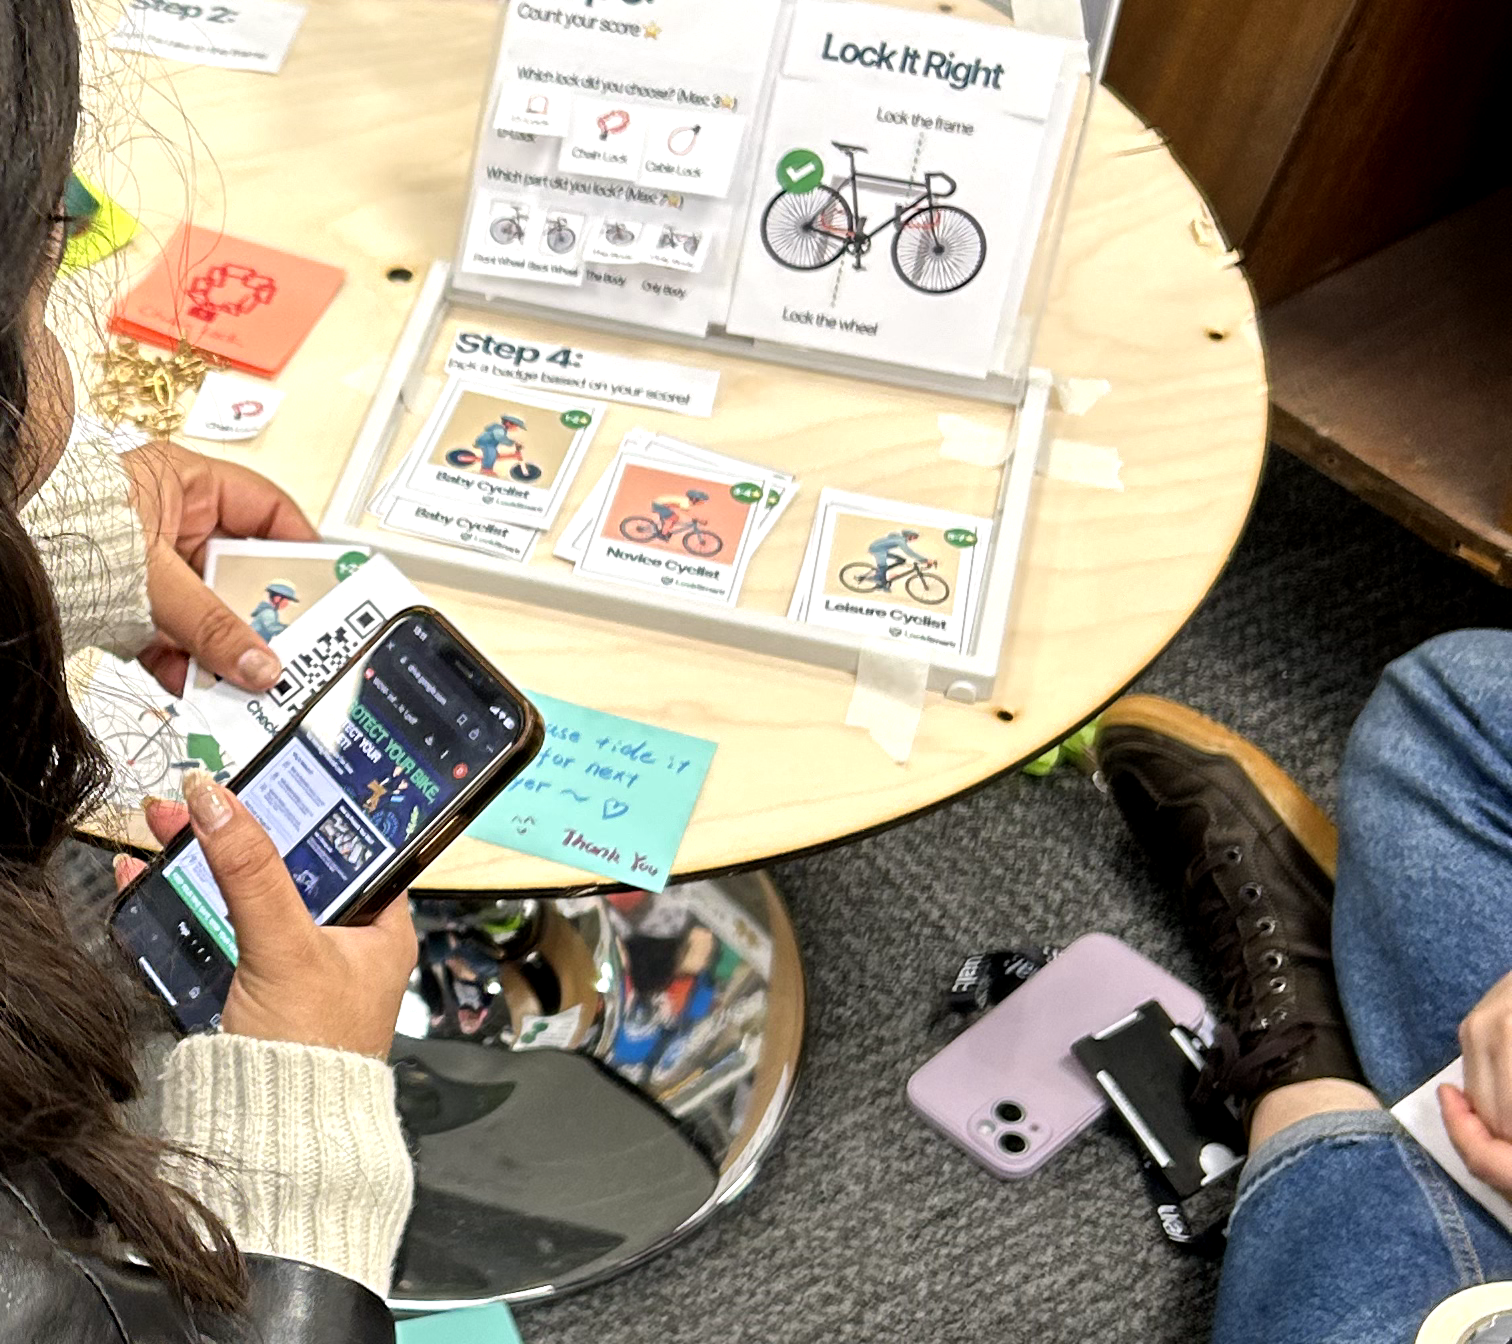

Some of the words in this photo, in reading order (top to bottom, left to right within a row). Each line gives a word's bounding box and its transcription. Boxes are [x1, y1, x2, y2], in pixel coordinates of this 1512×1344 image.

[206, 5, 239, 24] 2:
[517, 2, 565, 26] Count
[563, 10, 598, 30] your
[599, 18, 642, 38] score
[821, 33, 899, 72] Lock
[899, 47, 920, 75] It
[922, 51, 1006, 91] Right
[517, 66, 554, 83] Which
[554, 72, 580, 87] lock
[601, 80, 624, 94] you
[624, 82, 676, 101] choose?
[876, 107, 910, 127] Lock
[910, 111, 934, 130] the
[935, 115, 975, 136] frame
[486, 166, 523, 184] Which
[568, 180, 592, 196] you
[675, 165, 701, 178] Lock
[782, 308, 815, 327] Lock
[815, 311, 838, 329] the
[838, 318, 878, 337] wheel
[455, 332, 540, 367] Step
[545, 347, 585, 369] 4:
[480, 364, 490, 373] a
[492, 363, 539, 384] badge
[541, 371, 586, 390] based
[589, 379, 609, 393] on
[609, 382, 642, 398] your
[435, 470, 475, 491] Baby
[477, 477, 531, 500] Cyclist
[414, 506, 454, 525] Baby
[456, 513, 509, 538] Cyclist
[606, 545, 663, 570] Novice
[665, 557, 721, 581] Cyclist
[823, 598, 888, 621] Leisure
[889, 603, 948, 632] Cyclist
[358, 736, 383, 764] YOUR
[596, 736, 657, 765] ride
[384, 737, 417, 775] YOUR
[409, 767, 440, 806] BIKE,
[535, 747, 576, 769] for
[585, 761, 639, 788] next
[561, 828, 621, 864] Thank
[631, 851, 658, 877] You
